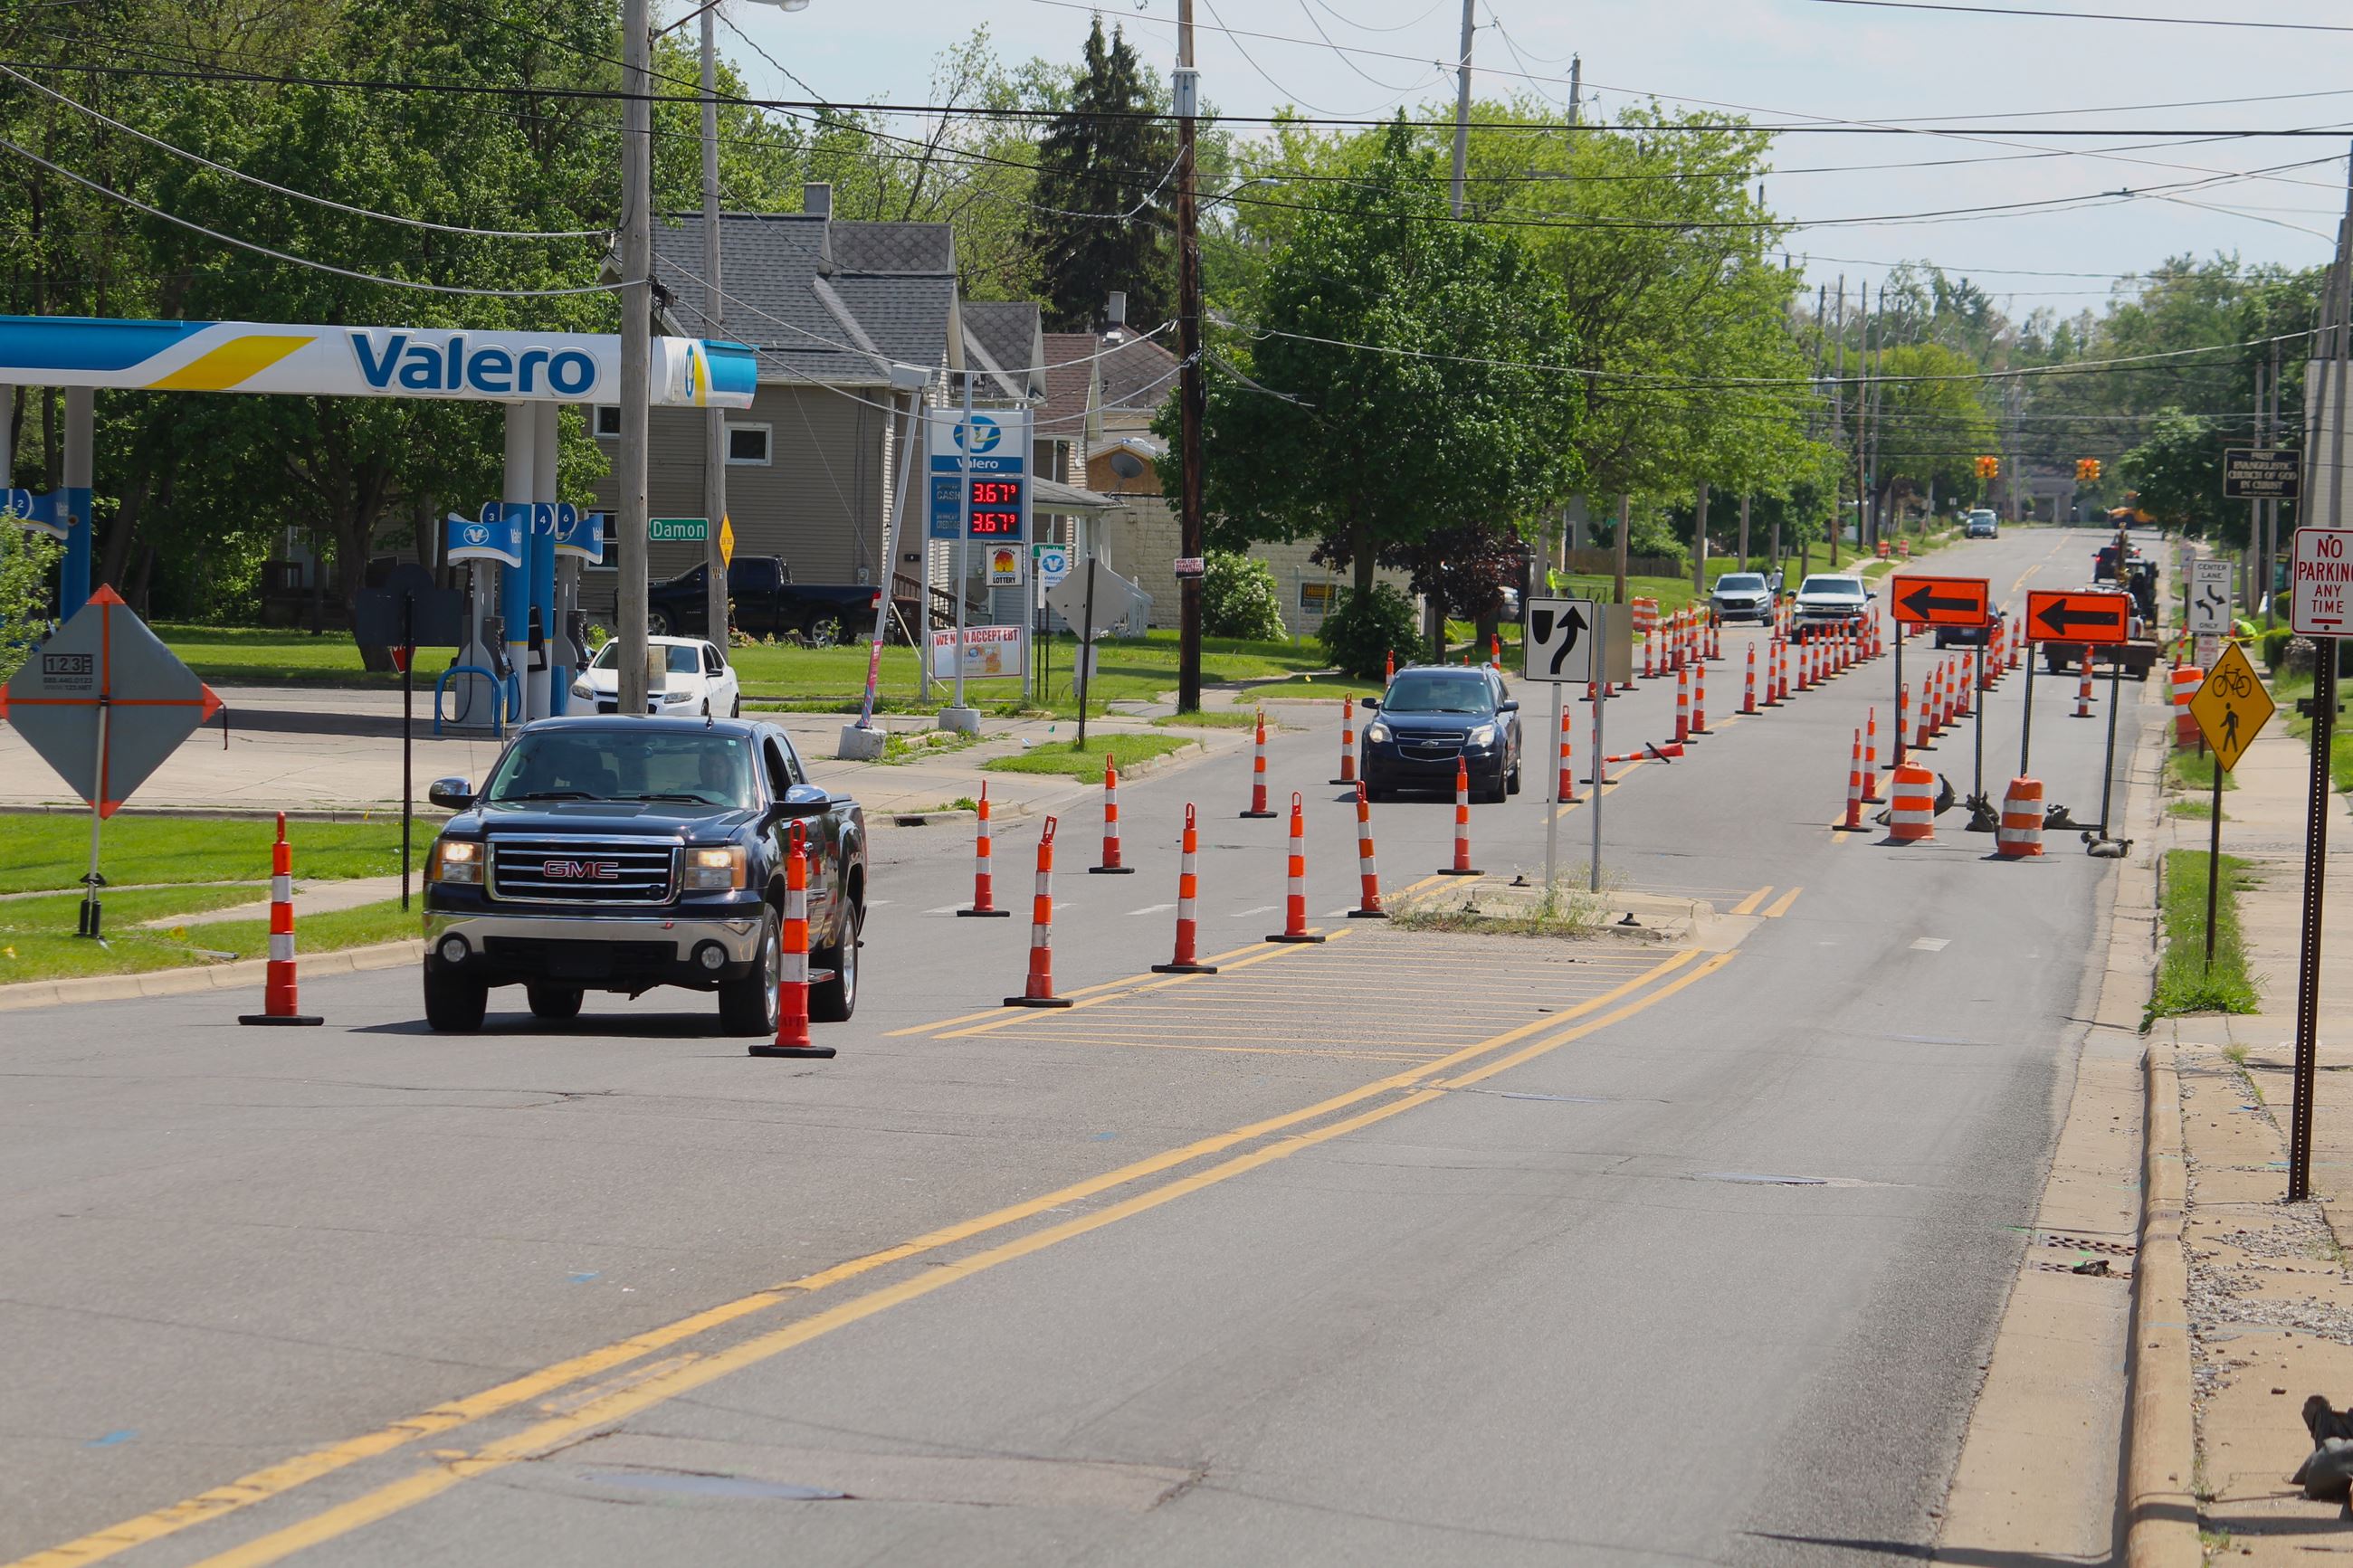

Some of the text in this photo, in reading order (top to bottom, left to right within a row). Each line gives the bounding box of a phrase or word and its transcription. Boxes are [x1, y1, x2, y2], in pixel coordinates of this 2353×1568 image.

[350, 333, 597, 395] Valero
[2251, 451, 2276, 461] FIRST
[957, 458, 999, 469] Vlero
[2233, 461, 2292, 470] EVANGELISTIC
[2228, 470, 2298, 480] CHURCH OF GOD
[2253, 480, 2284, 489] CHRIST
[18, 499, 24, 508] 2
[489, 512, 495, 521] 3
[540, 515, 547, 525] 4
[563, 513, 569, 523] 6
[653, 520, 705, 537] Damon
[2317, 538, 2343, 558] NO
[2298, 561, 2353, 582] PARKIN
[2314, 584, 2342, 598] ANY
[2311, 599, 2345, 613] TIME
[936, 629, 1018, 646] WE NW ACCEPT EBT
[47, 658, 81, 671] 123
[543, 860, 619, 879] GMC
